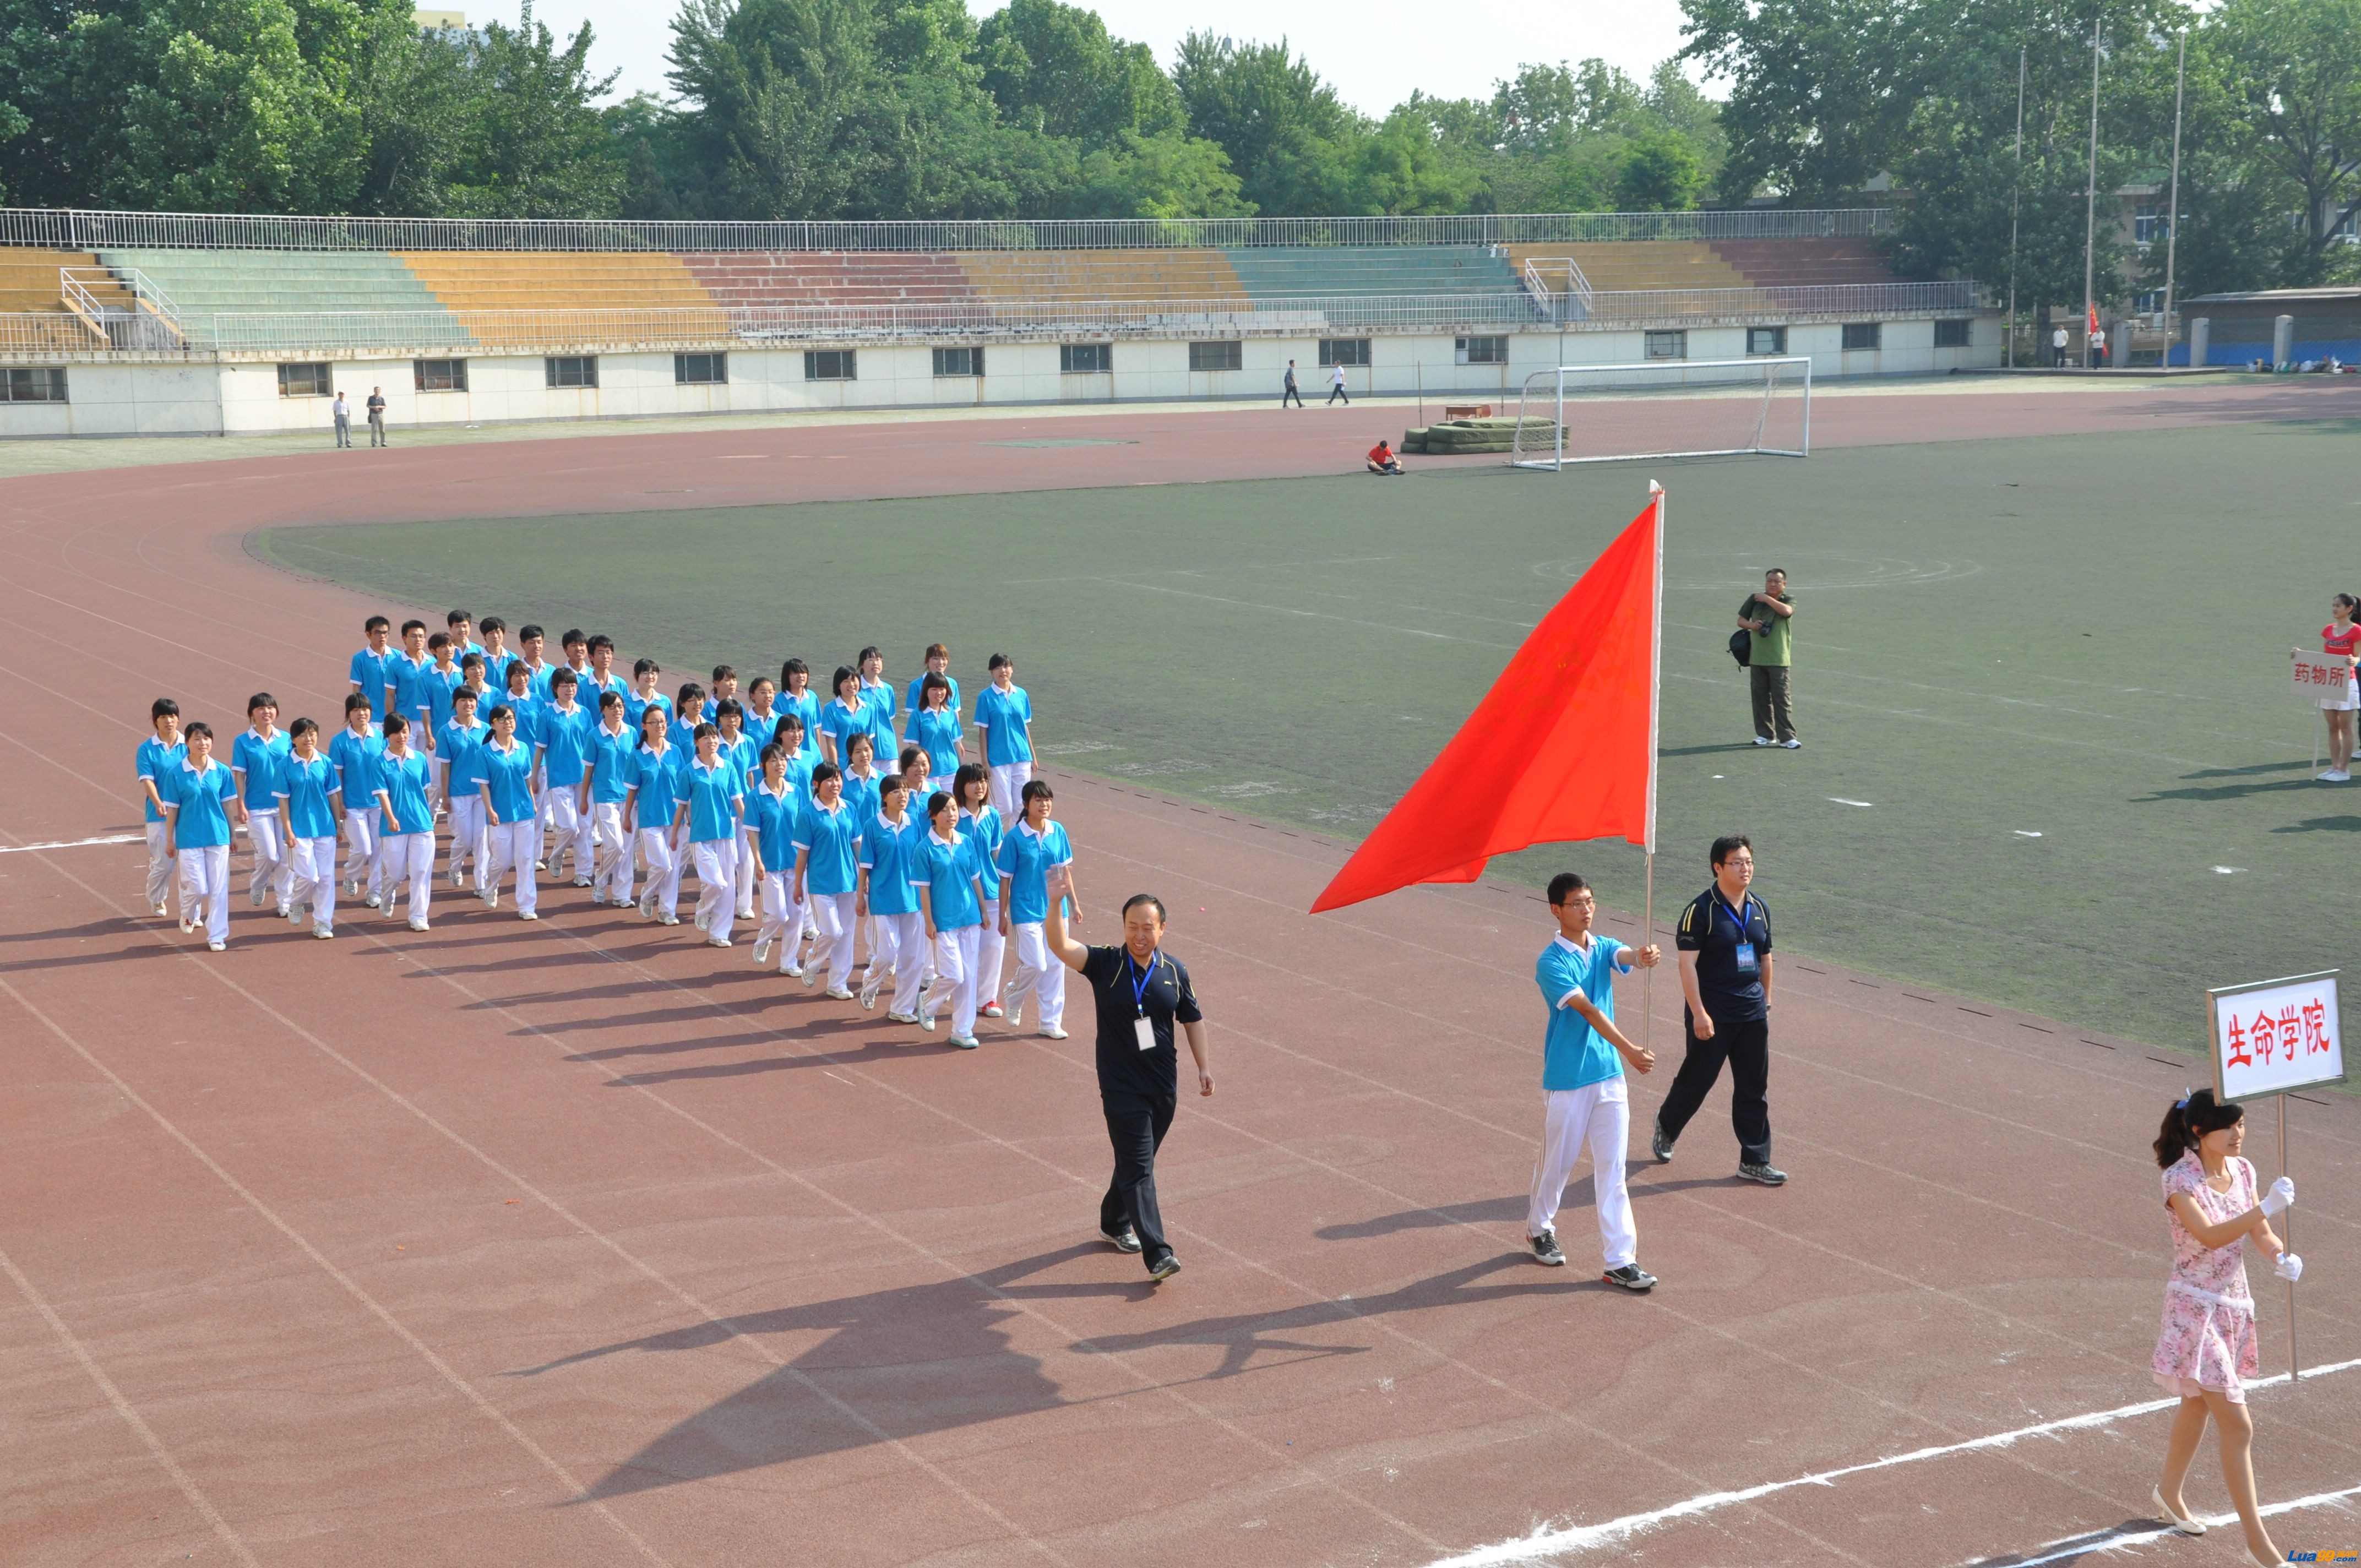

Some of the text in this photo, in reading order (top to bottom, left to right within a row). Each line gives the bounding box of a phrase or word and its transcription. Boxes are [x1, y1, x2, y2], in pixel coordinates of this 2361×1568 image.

[2294, 663, 2344, 688] 药物所
[2228, 998, 2330, 1069] 生命学院
